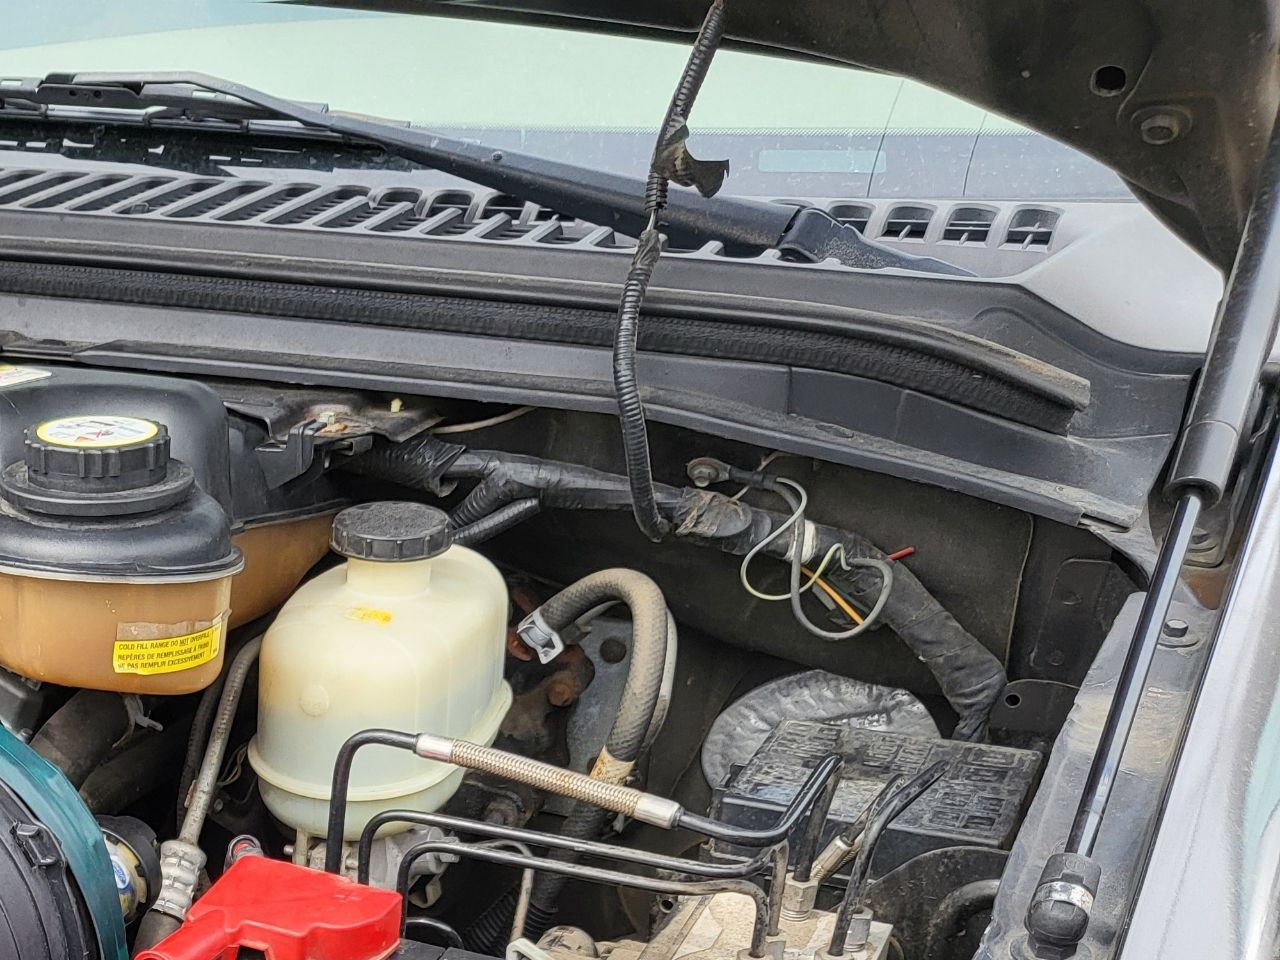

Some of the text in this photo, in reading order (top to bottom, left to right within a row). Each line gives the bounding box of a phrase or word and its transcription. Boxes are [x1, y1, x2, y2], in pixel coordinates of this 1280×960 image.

[190, 632, 210, 643] OVERFILL
[118, 653, 145, 661] REPÈRES
[156, 648, 192, 658] REMPLISSAGE
[141, 660, 166, 668] REMPLIR
[168, 652, 205, 667] EXCESSIVEMENT
